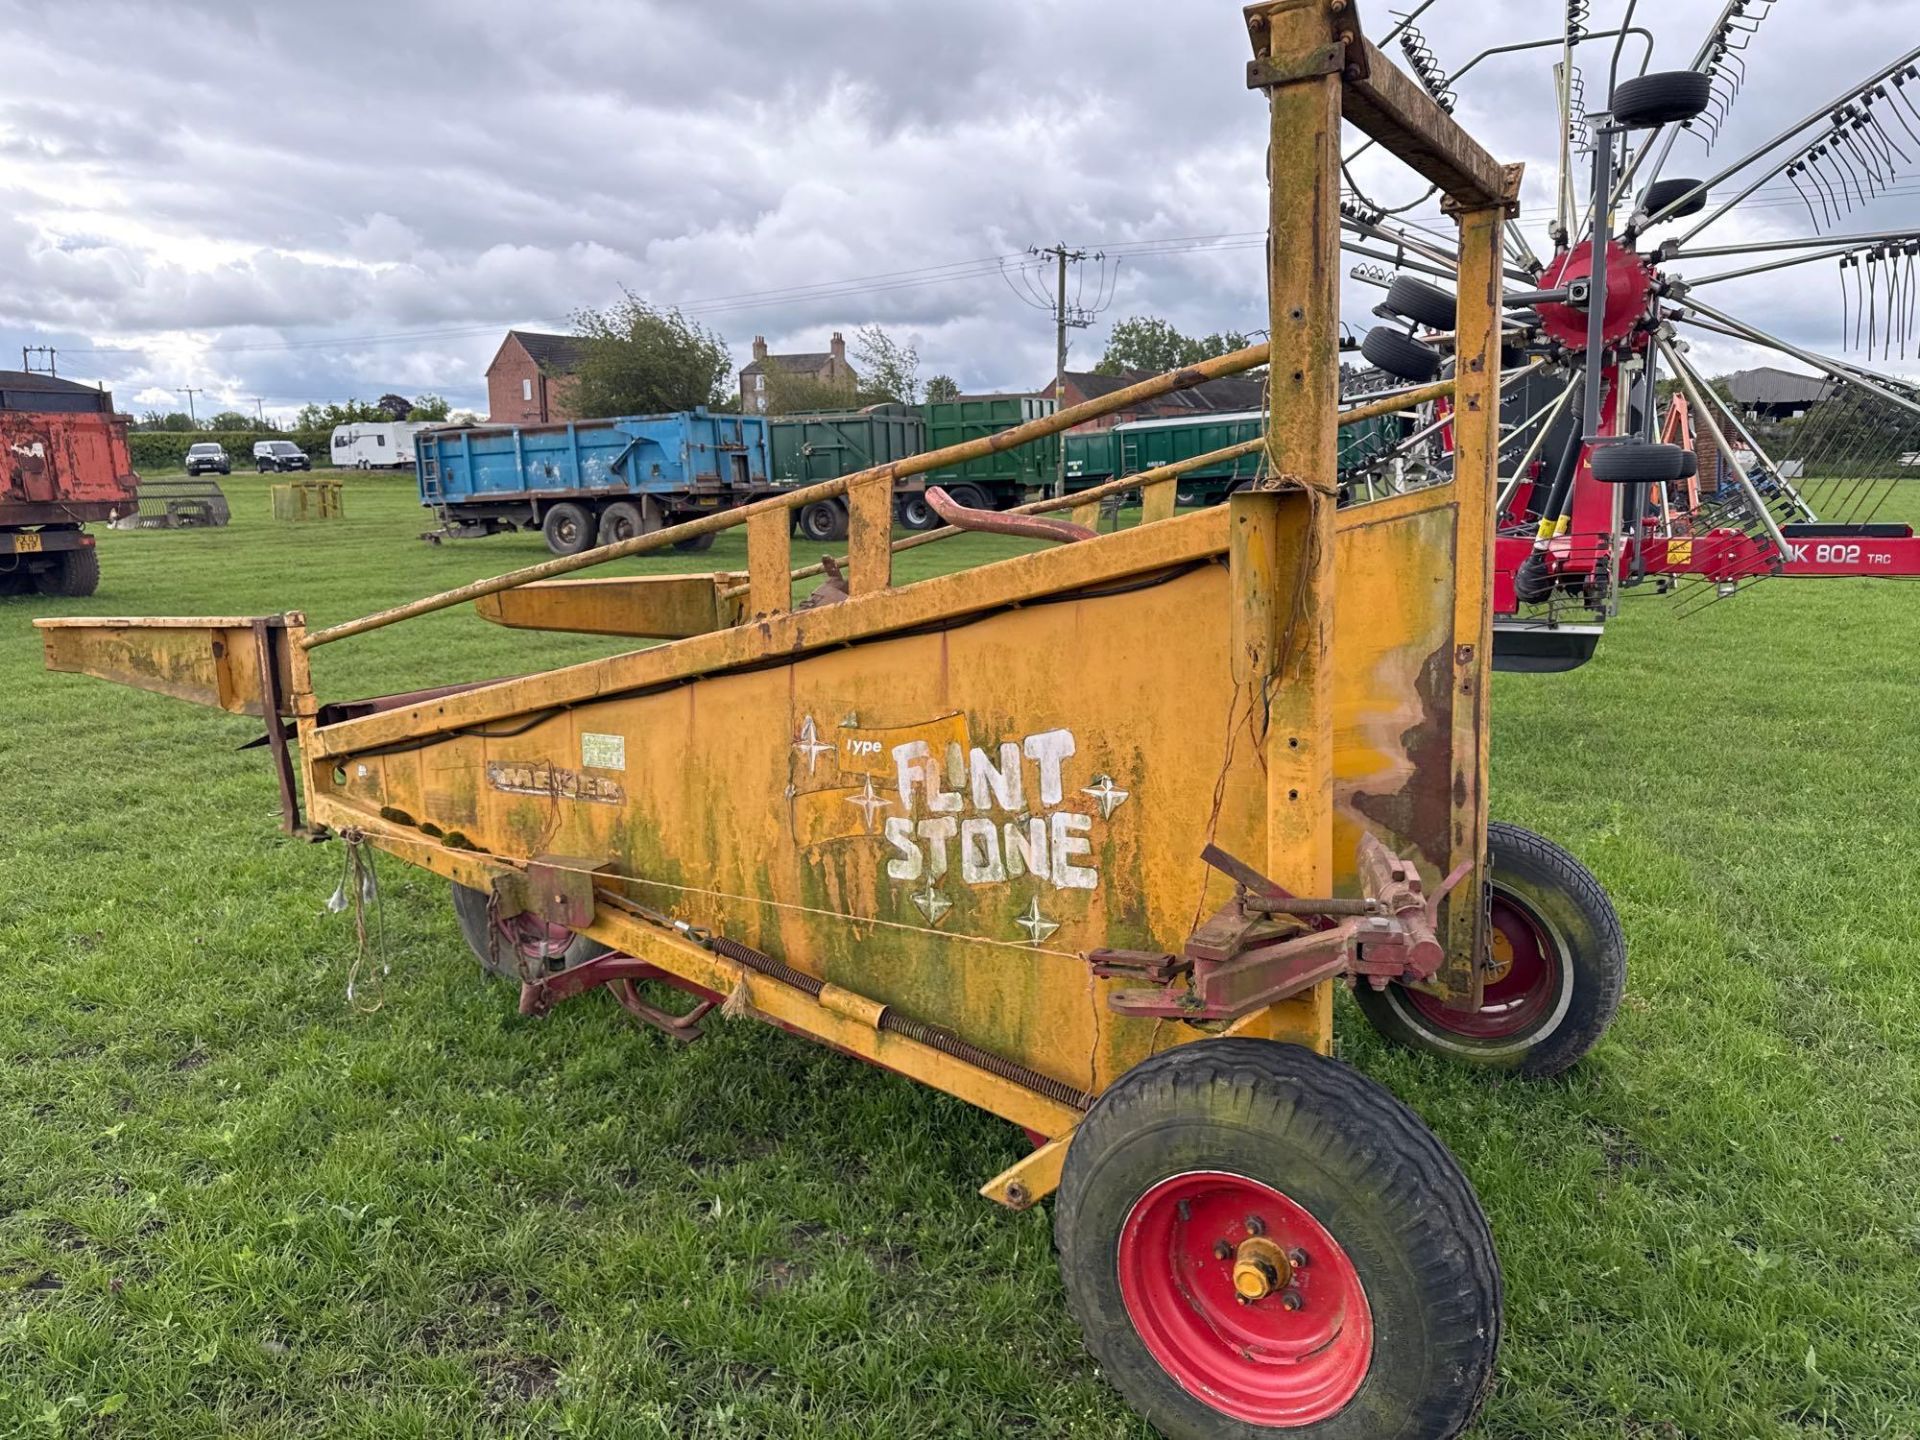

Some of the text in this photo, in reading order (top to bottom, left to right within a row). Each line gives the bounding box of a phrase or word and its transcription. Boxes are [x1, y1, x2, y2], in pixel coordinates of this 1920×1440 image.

[1816, 544, 1860, 563] 802
[1867, 554, 1891, 564] TRC
[891, 727, 1076, 811] FLINT
[884, 811, 1098, 889] STONE
